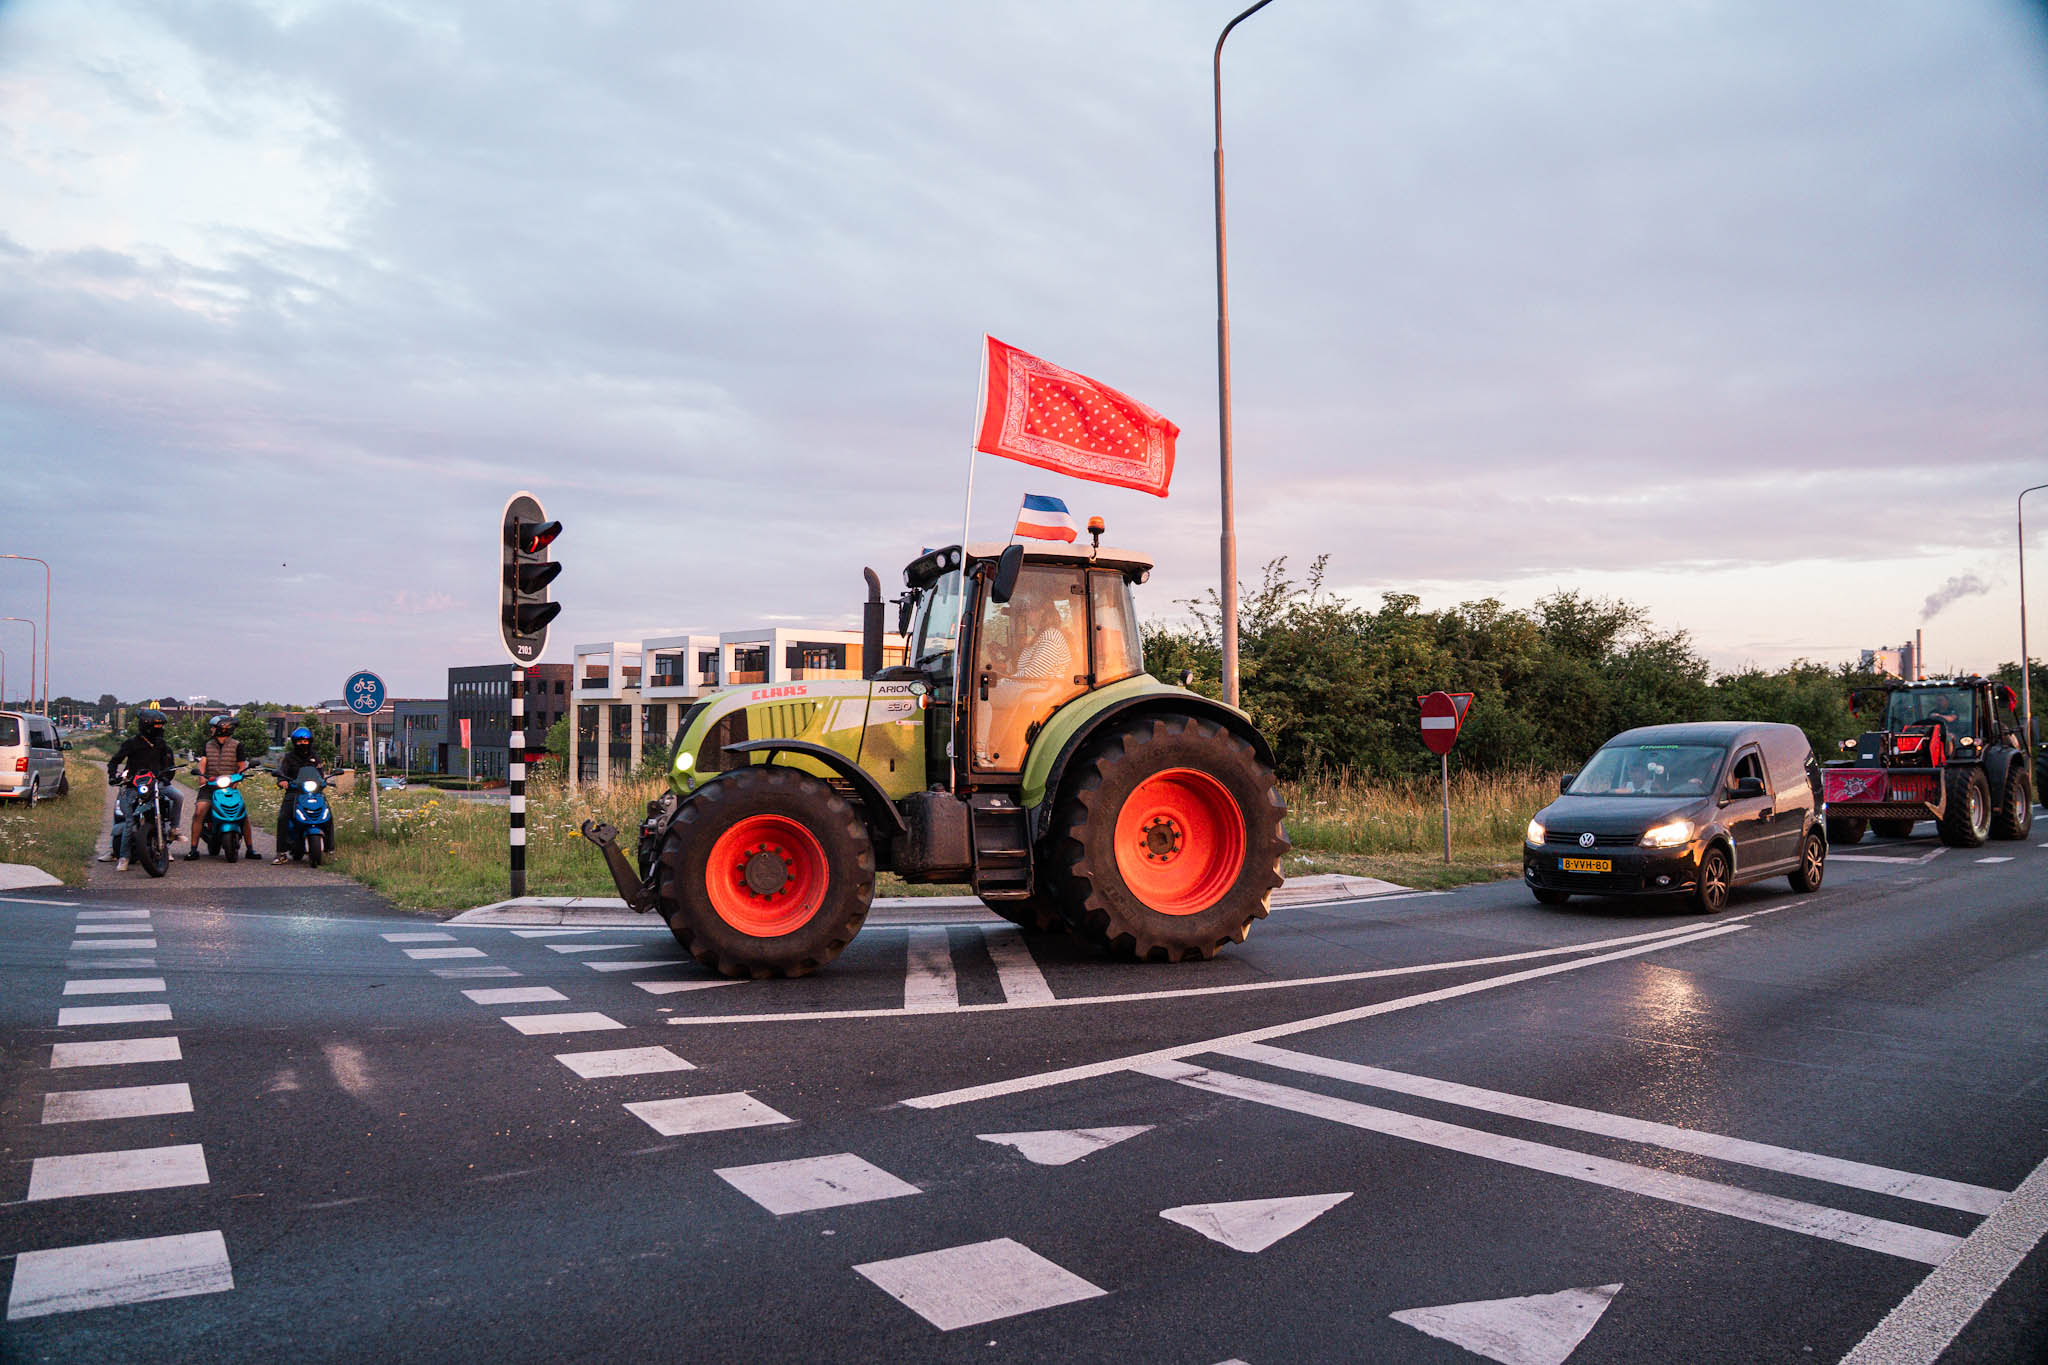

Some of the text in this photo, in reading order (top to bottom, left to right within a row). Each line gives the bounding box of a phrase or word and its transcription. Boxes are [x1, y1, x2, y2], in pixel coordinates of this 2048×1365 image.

[517, 645, 532, 655] 2101
[752, 685, 808, 700] CLAAS
[878, 685, 911, 693] ARION
[1564, 859, 1609, 870] 8-VVH-80
